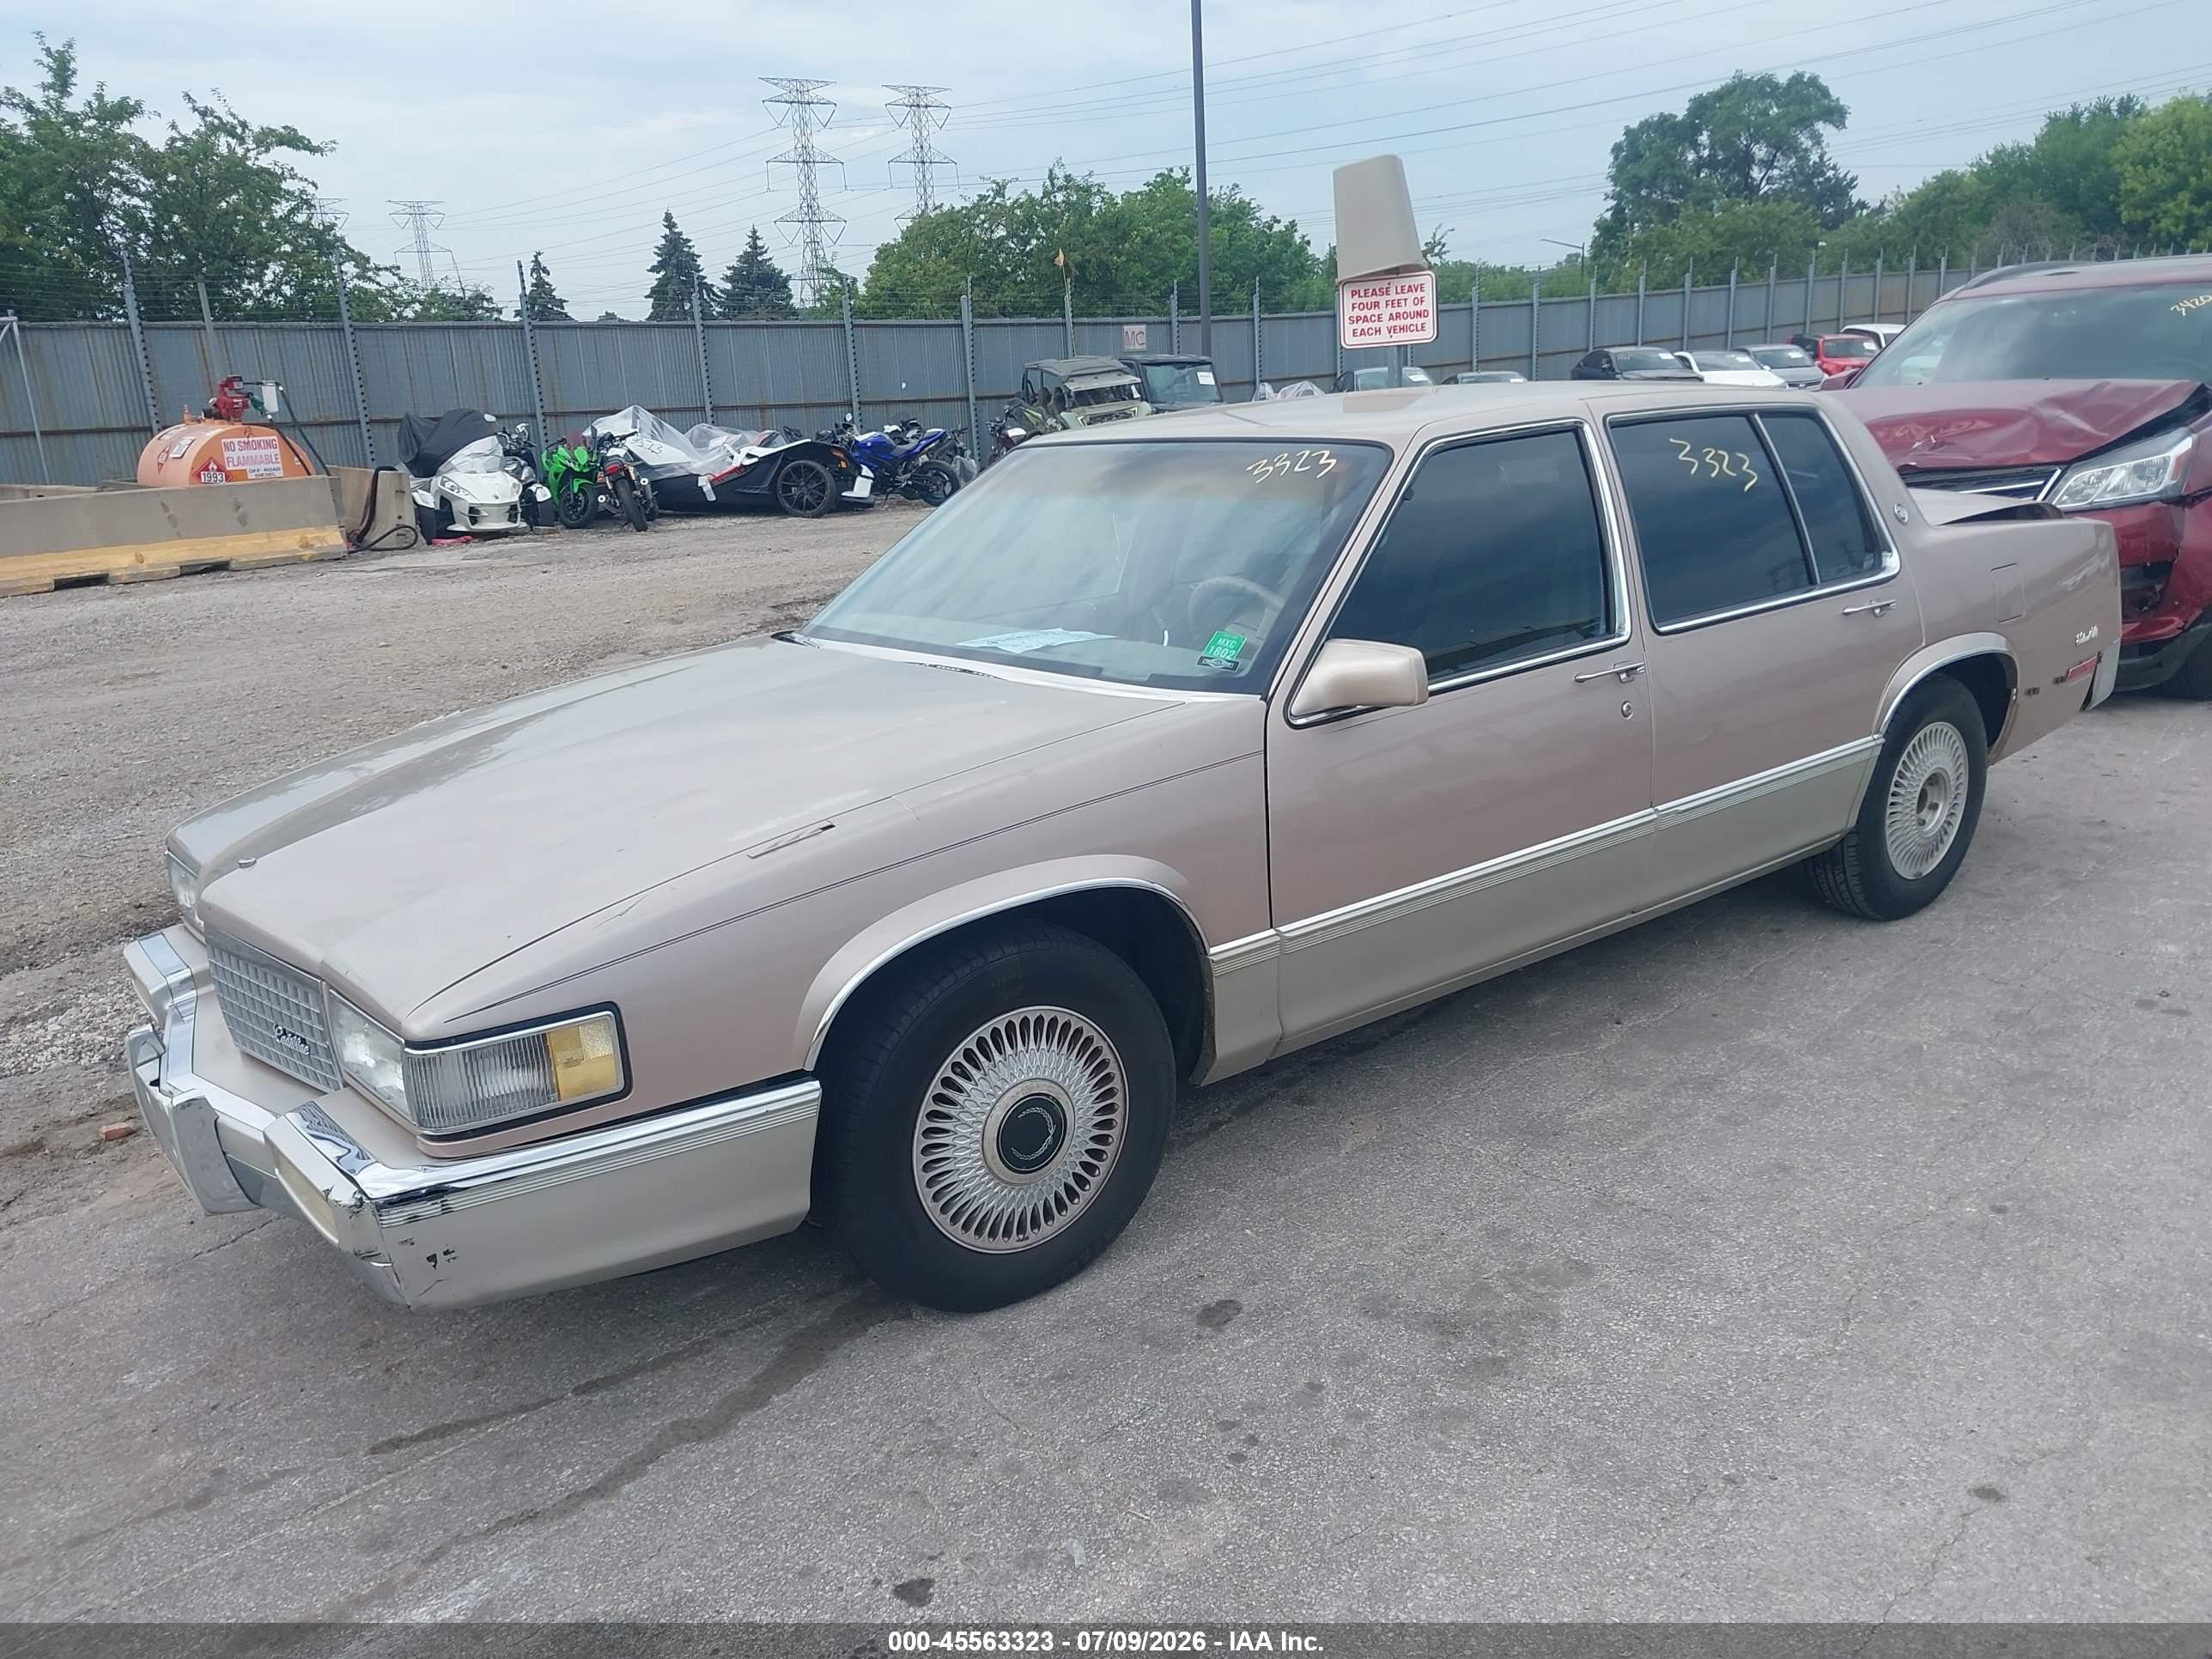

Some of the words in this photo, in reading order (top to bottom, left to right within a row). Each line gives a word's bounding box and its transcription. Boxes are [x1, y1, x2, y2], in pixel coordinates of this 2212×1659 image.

[1351, 287, 1391, 299] PLEASE
[1395, 283, 1425, 295] LEAVE
[1351, 301, 1380, 312] FOUR
[1385, 298, 1408, 309] FEET
[1413, 296, 1425, 306] OF
[1348, 313, 1383, 325] SPACE
[1388, 309, 1430, 322] AROUND
[1352, 327, 1382, 337] EACH
[1387, 323, 1426, 335] VEHICLE
[1126, 331, 1146, 346] MC
[223, 441, 236, 453] NO
[237, 438, 277, 452] SMOKING
[226, 453, 280, 467] FLAMMABLE
[1246, 450, 1337, 483] 3323
[1668, 437, 1758, 493] 3323
[203, 471, 224, 483] 1993
[1208, 646, 1237, 660] 1802
